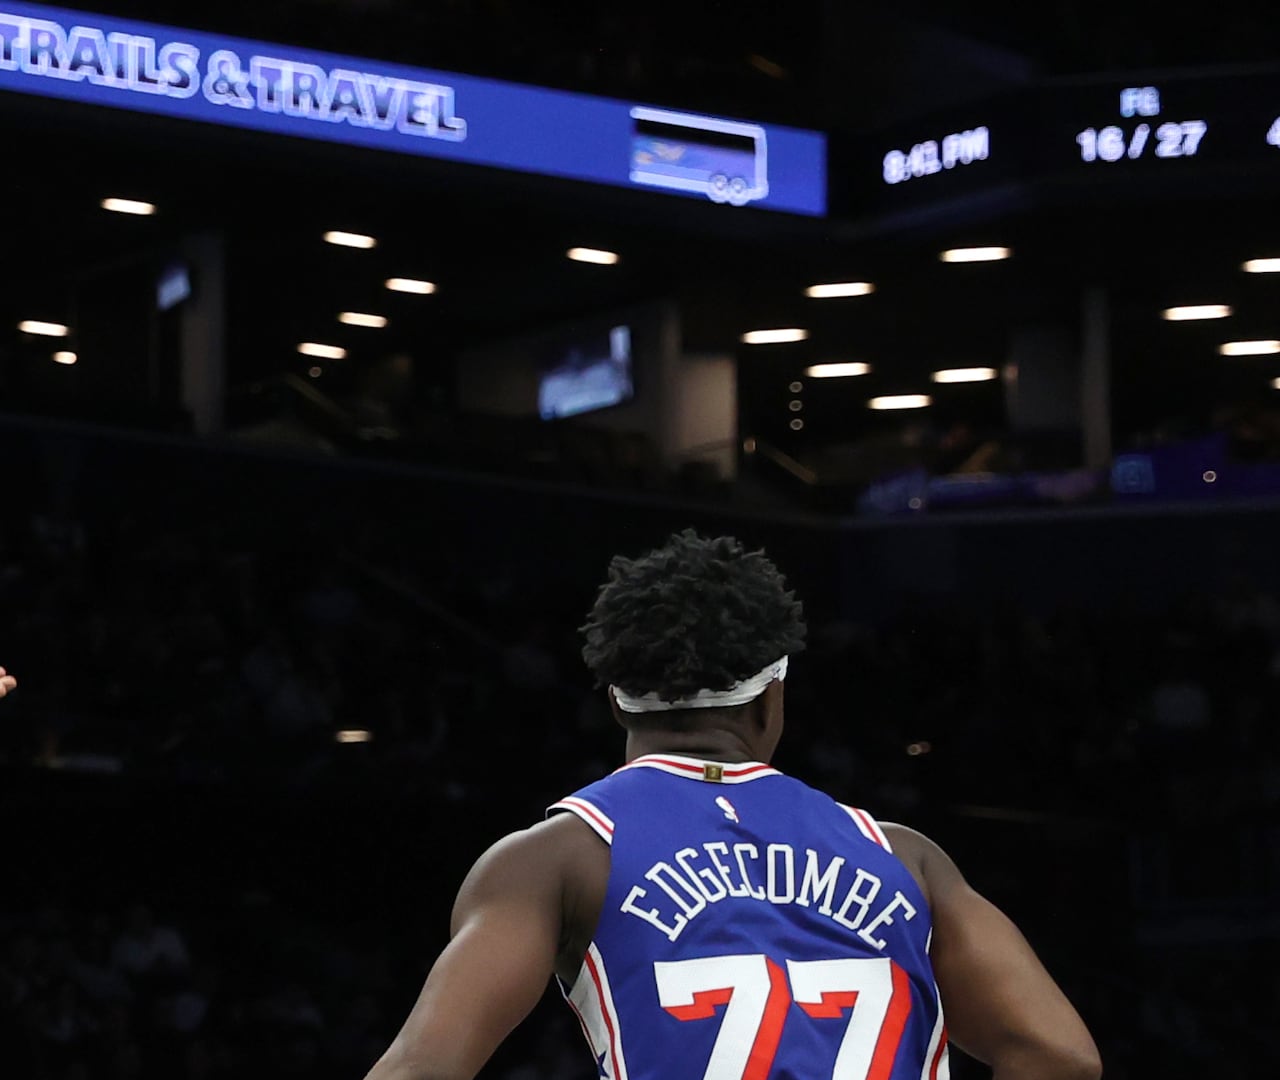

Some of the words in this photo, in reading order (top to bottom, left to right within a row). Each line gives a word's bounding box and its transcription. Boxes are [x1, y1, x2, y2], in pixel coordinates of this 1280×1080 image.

[249, 55, 467, 142] TRAVEL
[942, 126, 989, 169] PM
[620, 841, 918, 950] EDGECOMBE
